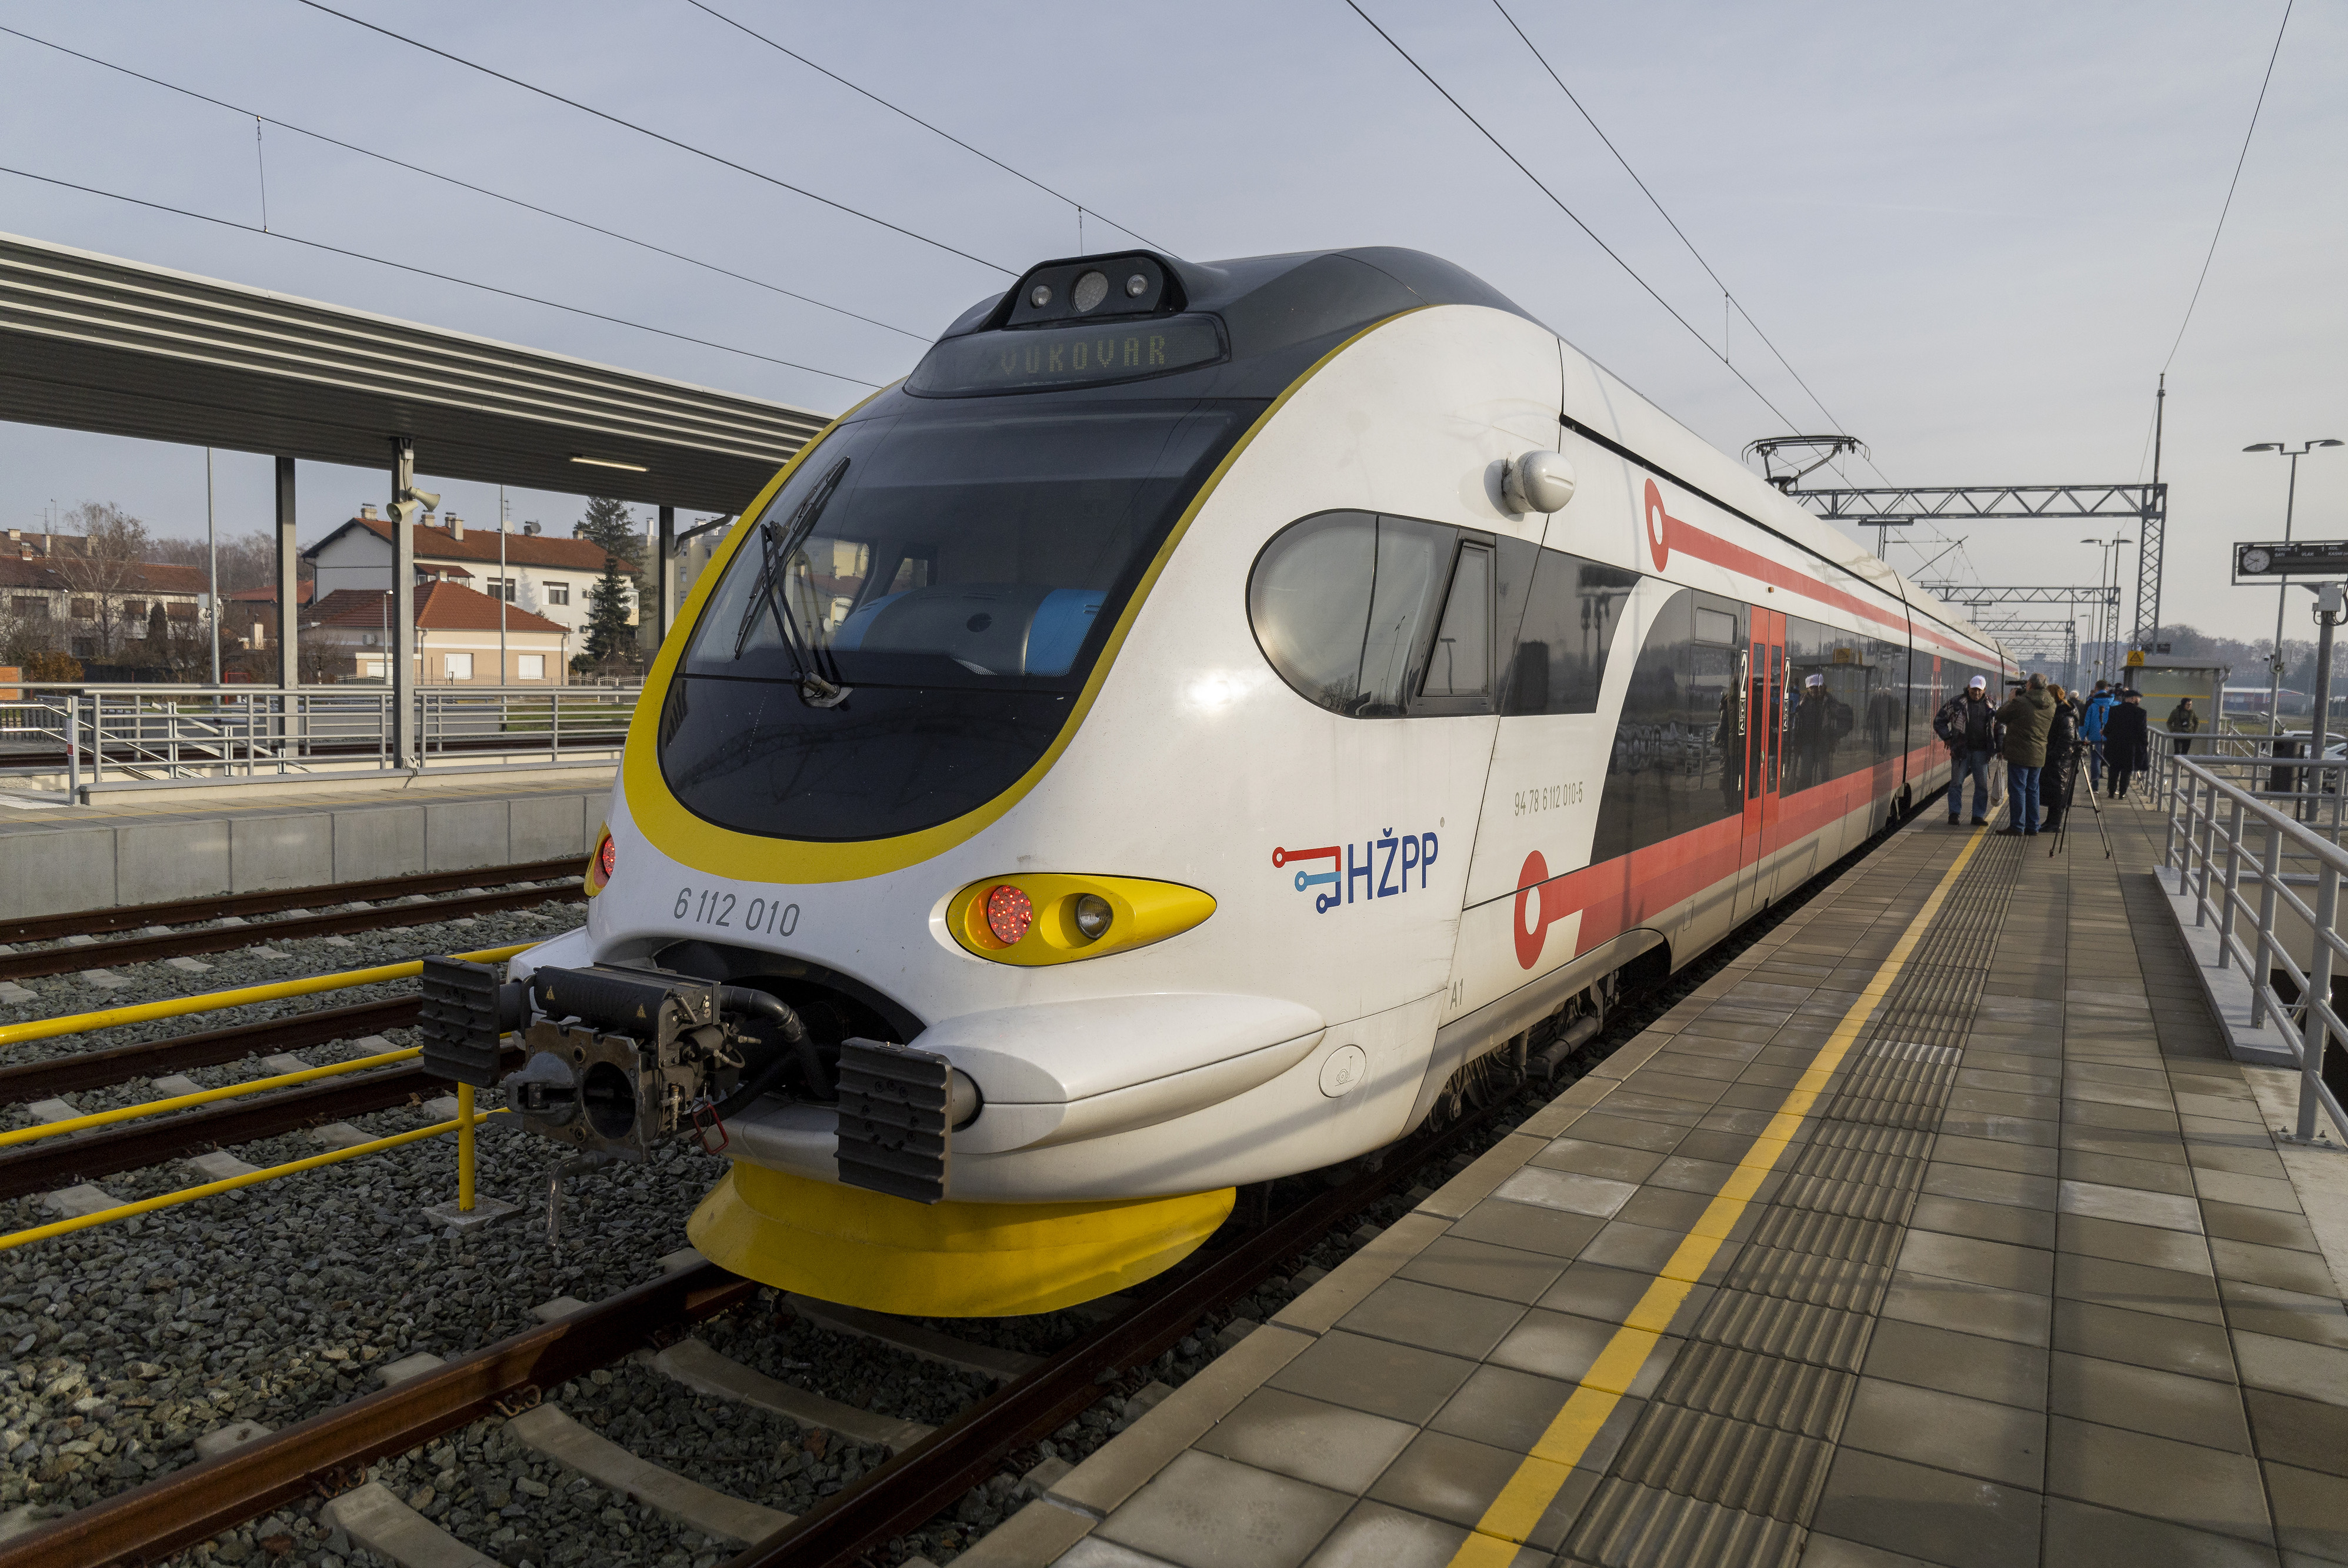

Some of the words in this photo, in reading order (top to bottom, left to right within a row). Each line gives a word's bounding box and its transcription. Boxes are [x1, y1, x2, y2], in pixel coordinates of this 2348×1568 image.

[1000, 335, 1165, 375] VUKOVAR
[1740, 653, 1747, 698] 2
[1784, 660, 1790, 699] 2
[1515, 790, 1526, 816] 94
[1529, 789, 1539, 813] 78
[1543, 788, 1547, 810] 6
[1550, 785, 1560, 809] 112
[1563, 781, 1583, 806] 010-5
[1348, 827, 1439, 904] HŽPP
[673, 887, 692, 919] 6
[696, 890, 736, 927] 112
[745, 898, 801, 937] 010
[1449, 978, 1463, 1010] A1
